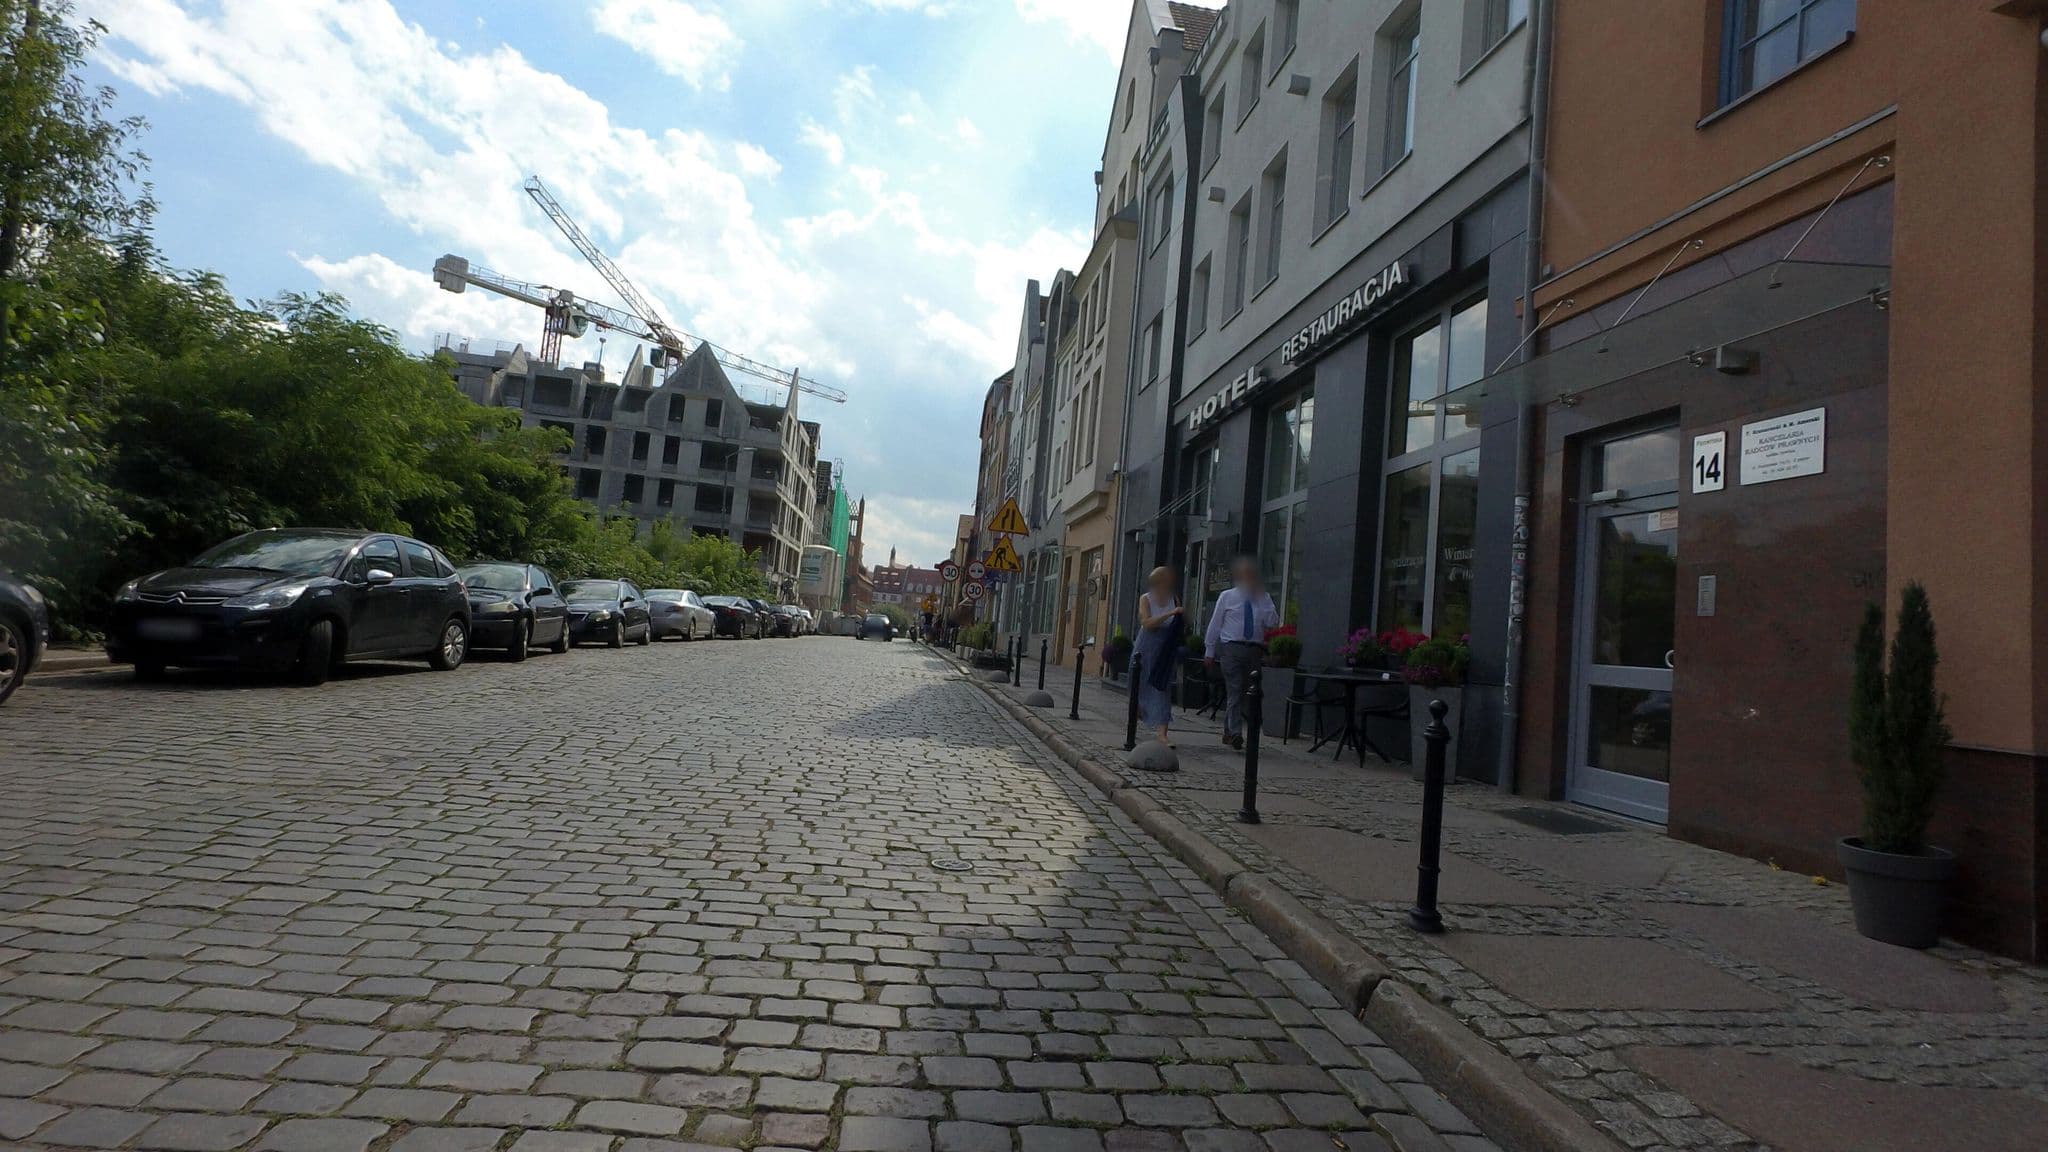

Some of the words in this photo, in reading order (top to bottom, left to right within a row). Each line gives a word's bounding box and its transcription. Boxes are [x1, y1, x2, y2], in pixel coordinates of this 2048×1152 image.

[1281, 261, 1404, 365] RESTAURACJA
[1189, 366, 1264, 430] HOTEL
[1695, 451, 1721, 486] 14
[944, 567, 957, 578] 30
[968, 584, 981, 596] 30
